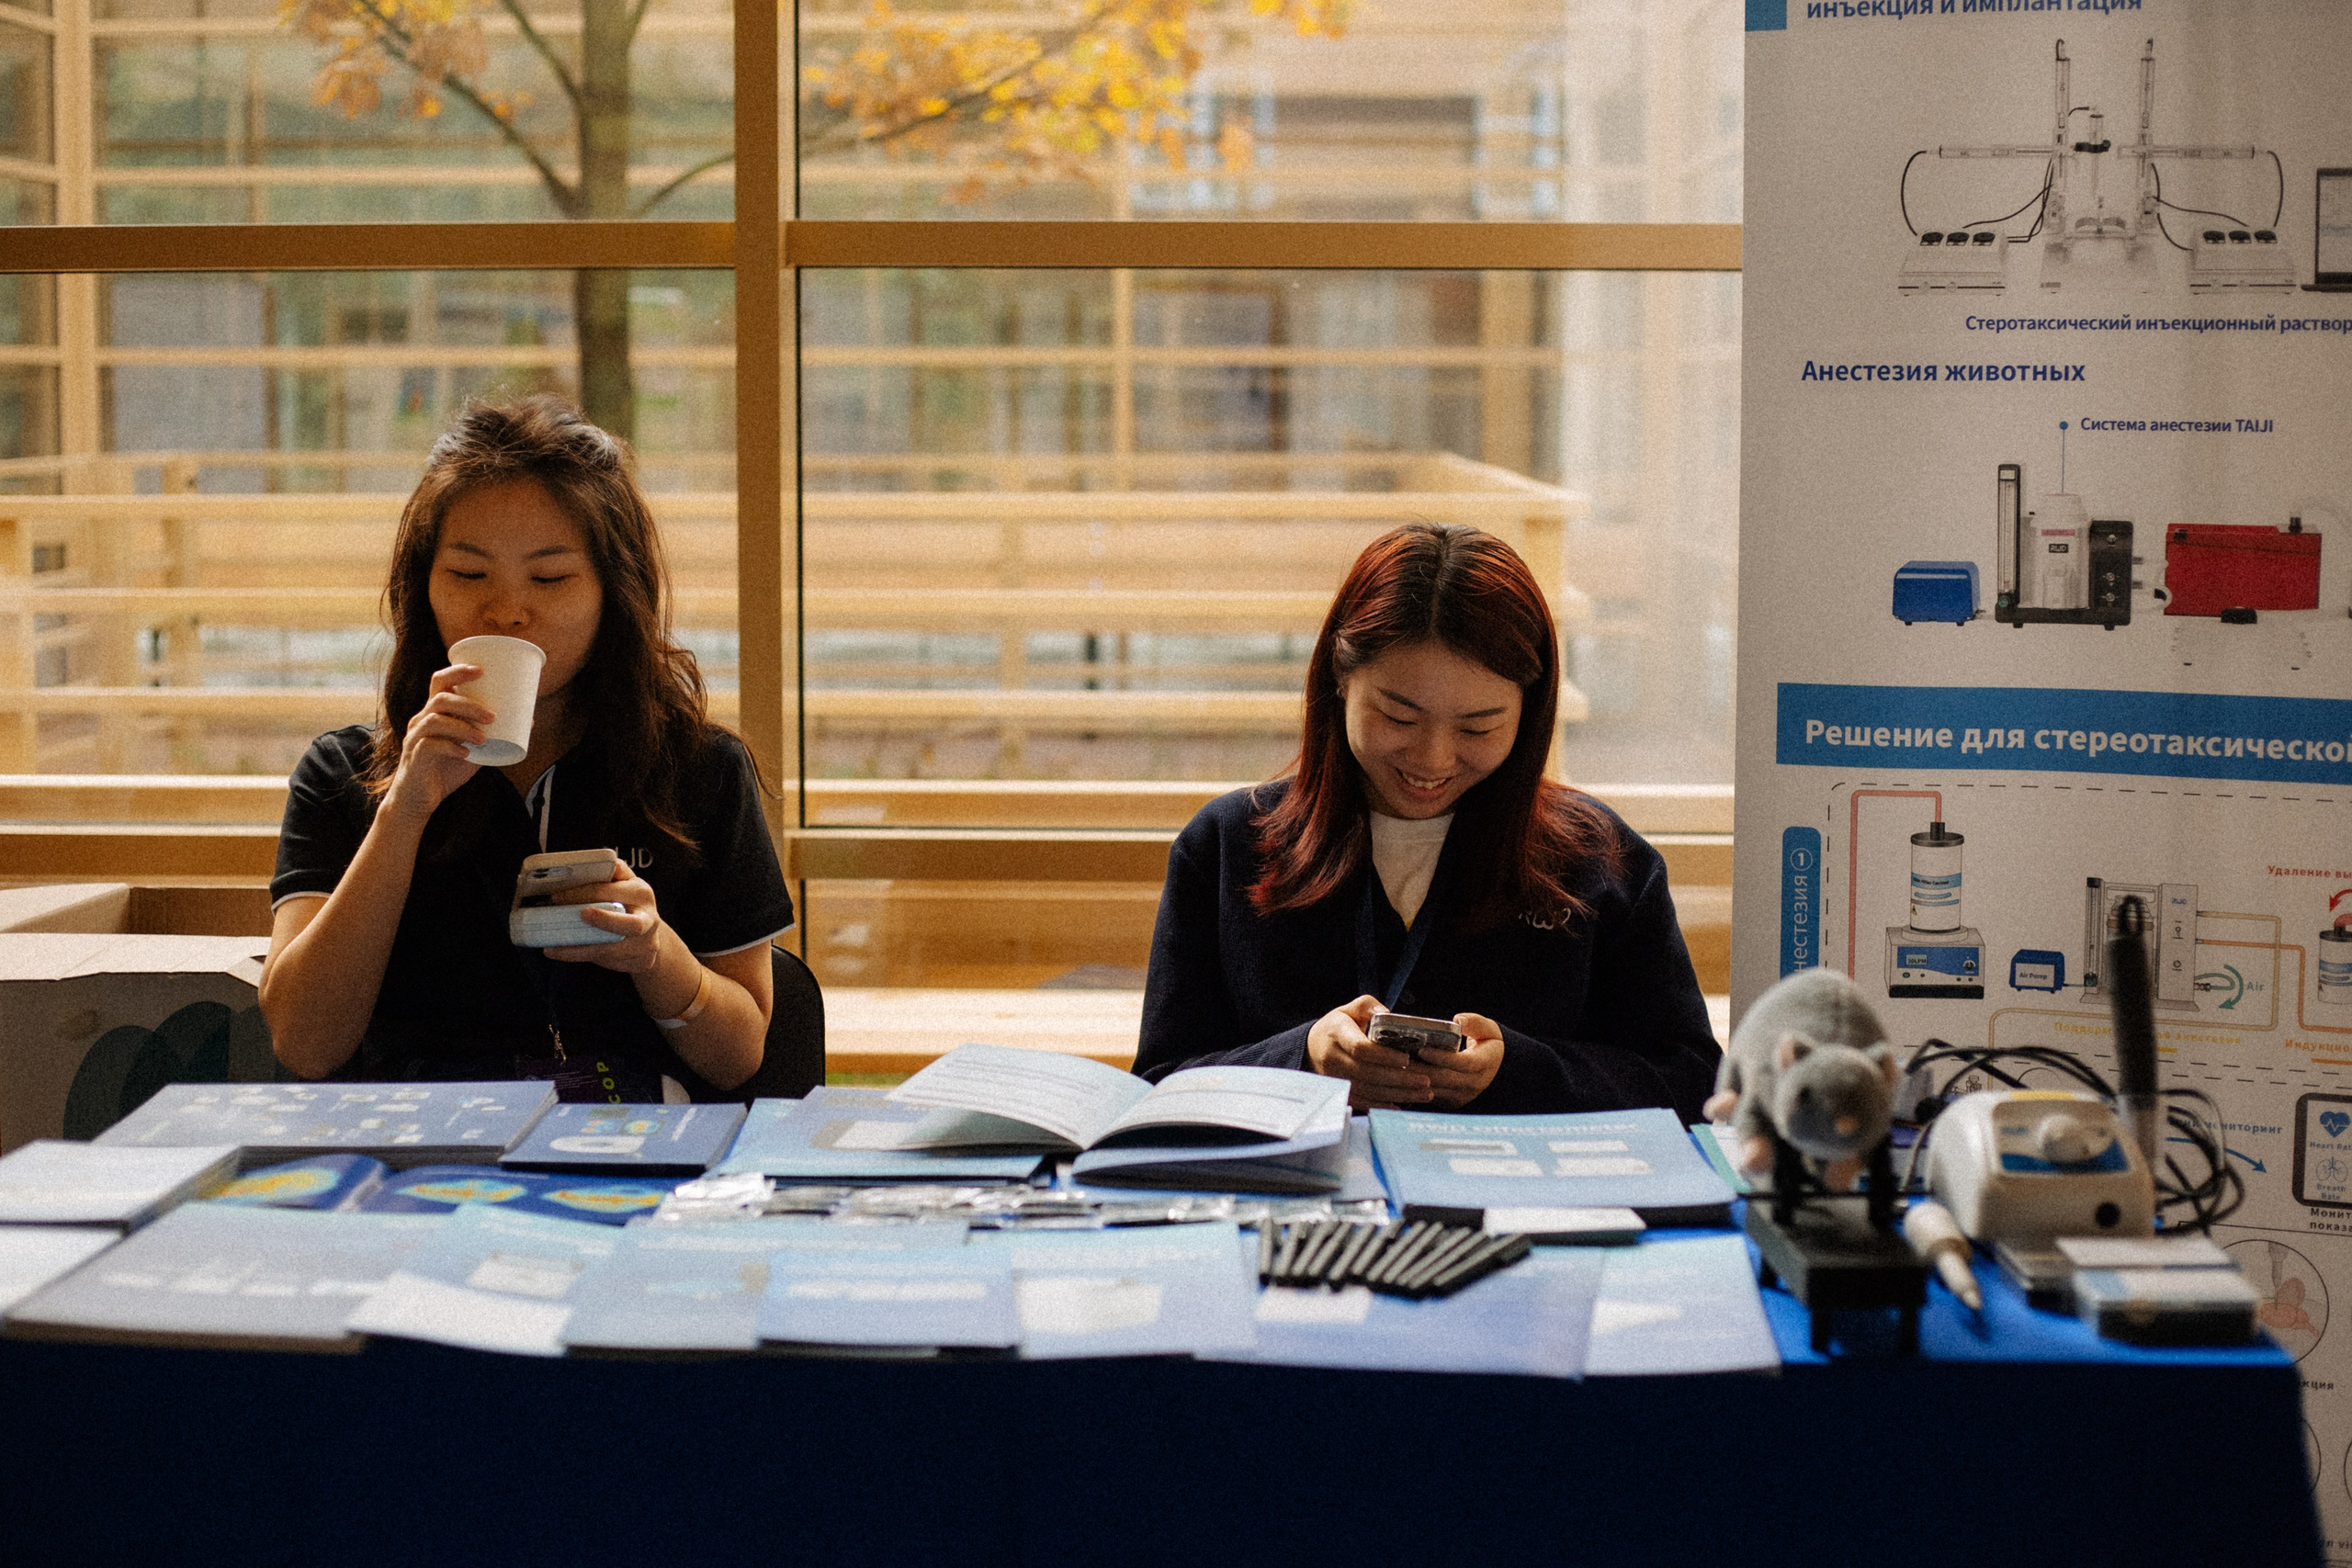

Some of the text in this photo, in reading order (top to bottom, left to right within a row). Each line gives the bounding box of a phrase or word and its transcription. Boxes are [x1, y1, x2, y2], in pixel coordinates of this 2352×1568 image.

[1806, 0, 1932, 20] инъекция
[1940, 0, 1955, 14] и
[1965, 314, 2132, 334] Стеротаксический
[2135, 314, 2276, 335] инъекционный
[1802, 360, 2086, 383] Анестезия животных
[2080, 417, 2274, 434] Система анестезии TAIJI
[1805, 719, 1952, 749] Решение
[1961, 728, 2024, 753] для
[2267, 865, 2331, 878] Удаление
[1794, 875, 1808, 973] нестезия
[2030, 972, 2048, 981] Pump
[2246, 981, 2265, 992] Air
[2310, 1141, 2352, 1151] Heart Rat
[2316, 1183, 2346, 1192] Breath
[2321, 1192, 2341, 1201] Rate
[2311, 1207, 2351, 1219] Монит
